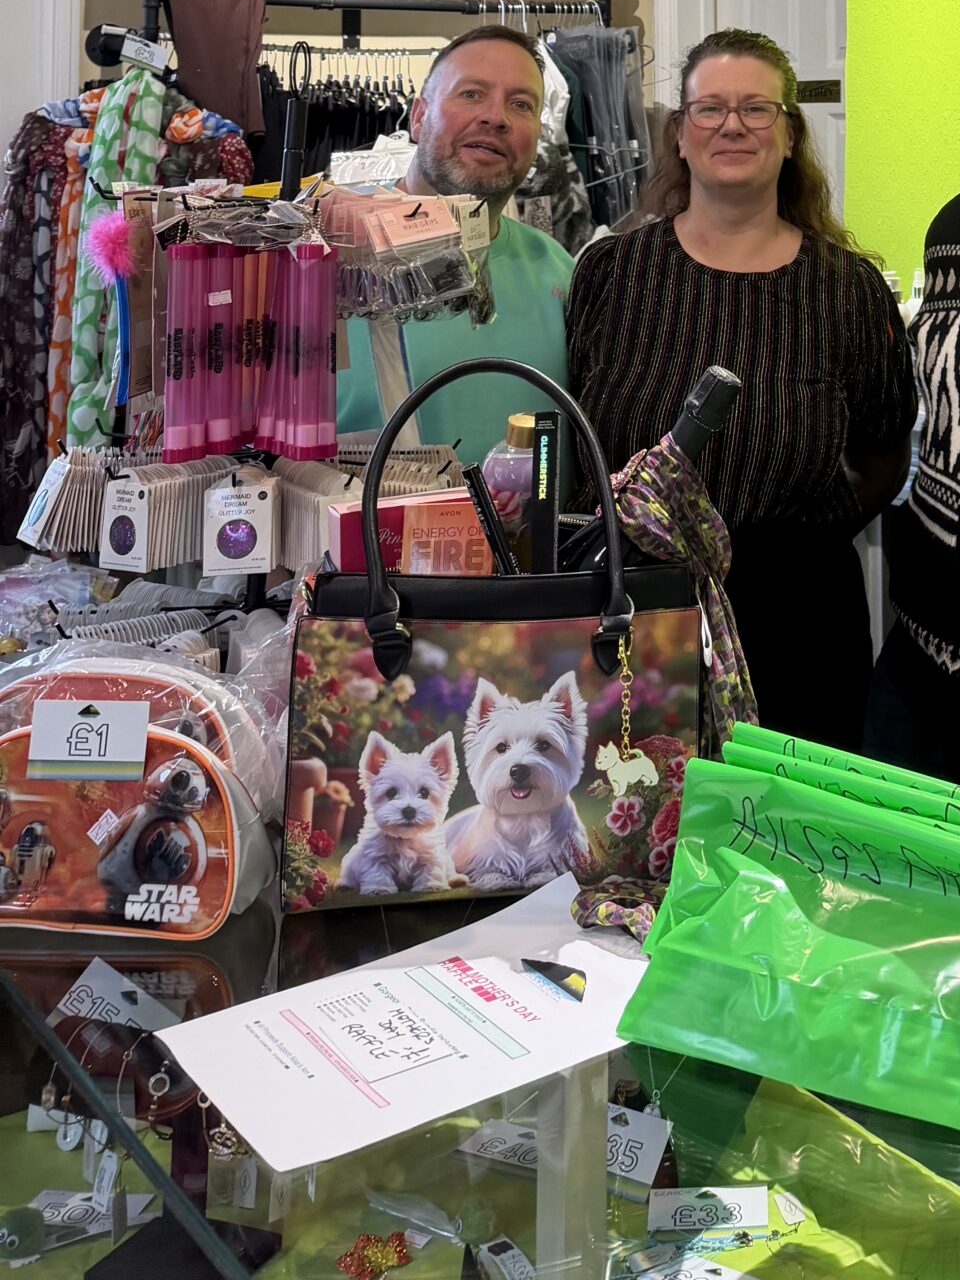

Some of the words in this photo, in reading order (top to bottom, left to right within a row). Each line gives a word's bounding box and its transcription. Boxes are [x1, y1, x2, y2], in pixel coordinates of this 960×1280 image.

[402, 223, 418, 231] HAIR
[538, 434, 549, 500] GLIMMERSTICK
[217, 509, 243, 517] GLITTER
[412, 526, 464, 538] ENERGY
[411, 538, 486, 571] FIRE
[66, 722, 110, 757] £1
[127, 884, 200, 904] STAR
[125, 903, 199, 924] WARS
[437, 960, 476, 988] RAFFLE
[470, 971, 520, 1008] MOTHER'S
[513, 1004, 542, 1022] DAY
[341, 1022, 399, 1060] RAFFLE
[378, 1019, 406, 1040] DAY
[607, 1133, 644, 1173] 35
[671, 1202, 743, 1228] £33
